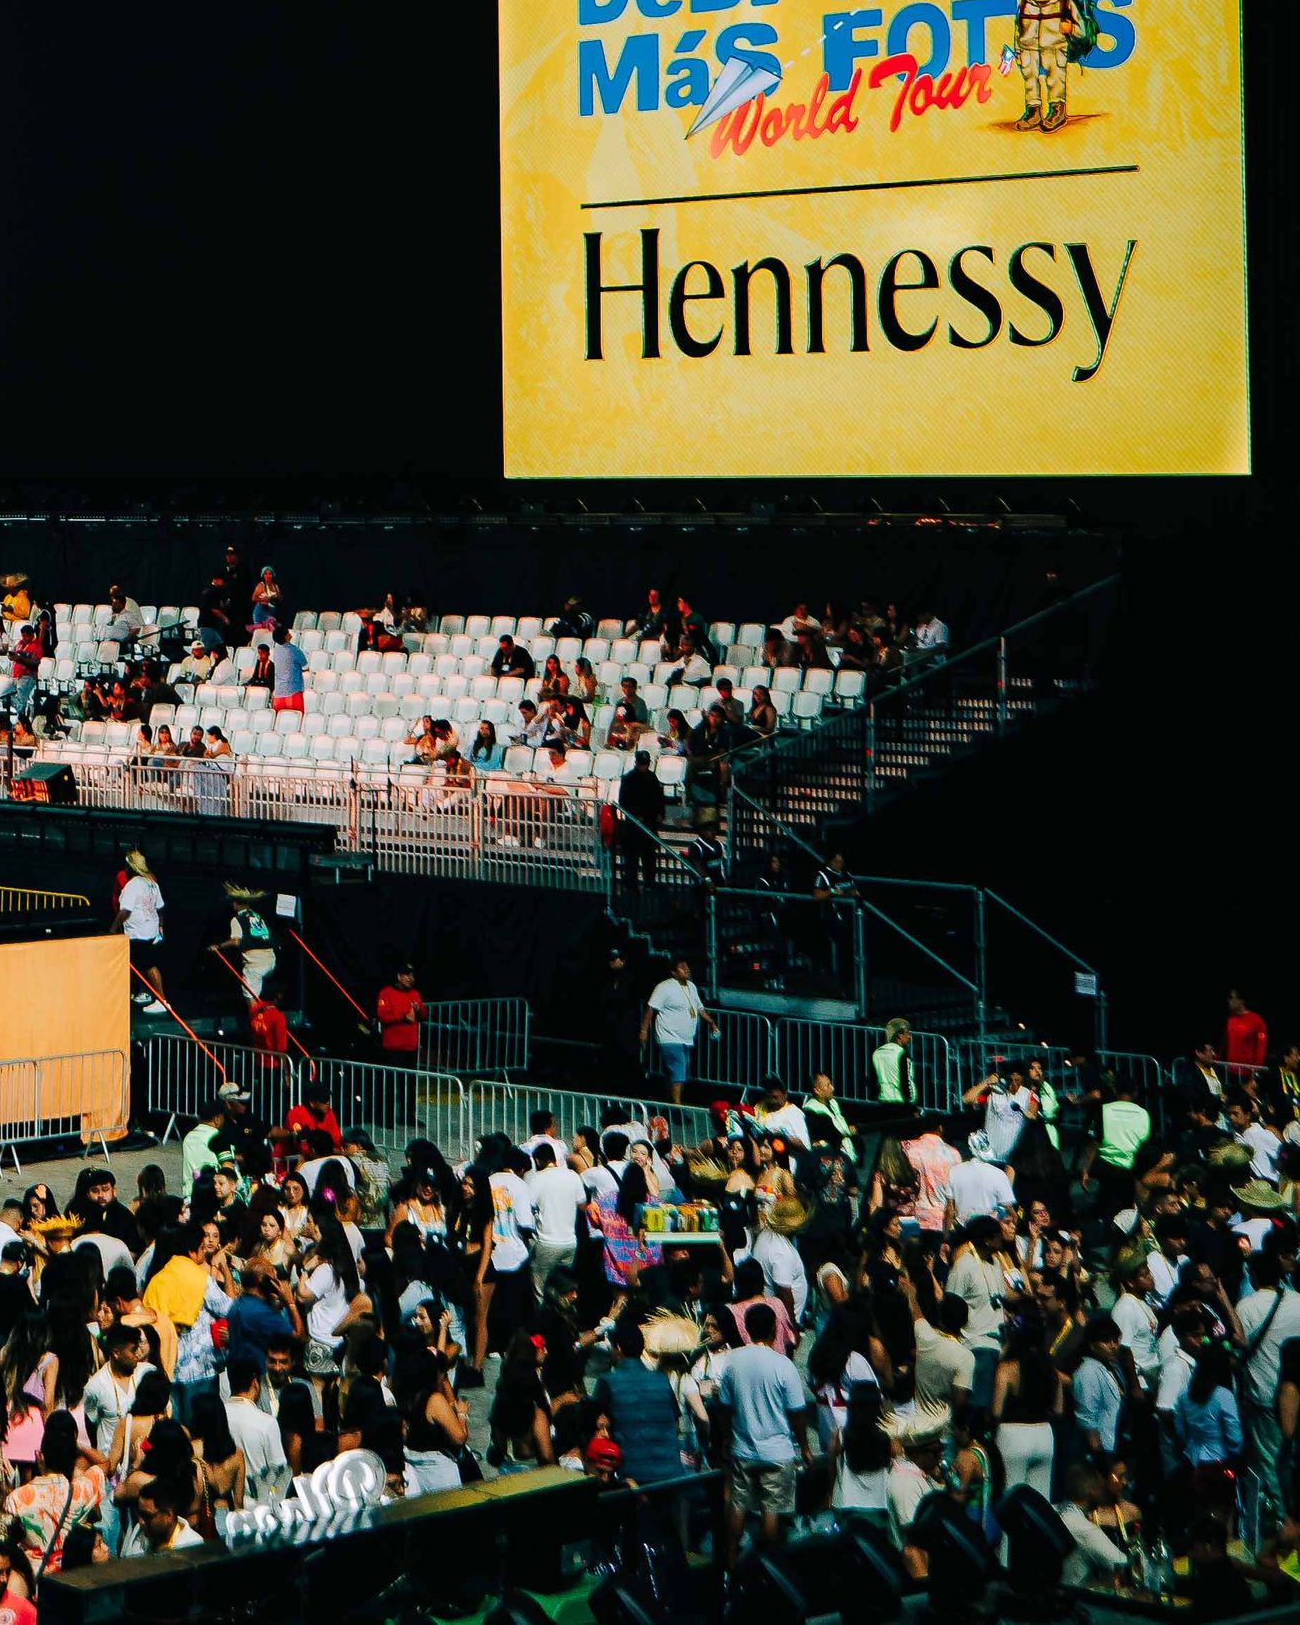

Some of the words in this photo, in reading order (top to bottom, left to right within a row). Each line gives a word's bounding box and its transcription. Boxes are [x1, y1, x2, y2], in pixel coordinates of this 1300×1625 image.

[710, 67, 862, 160] World
[868, 52, 993, 133] Tour
[582, 227, 1138, 384] Hennessy
